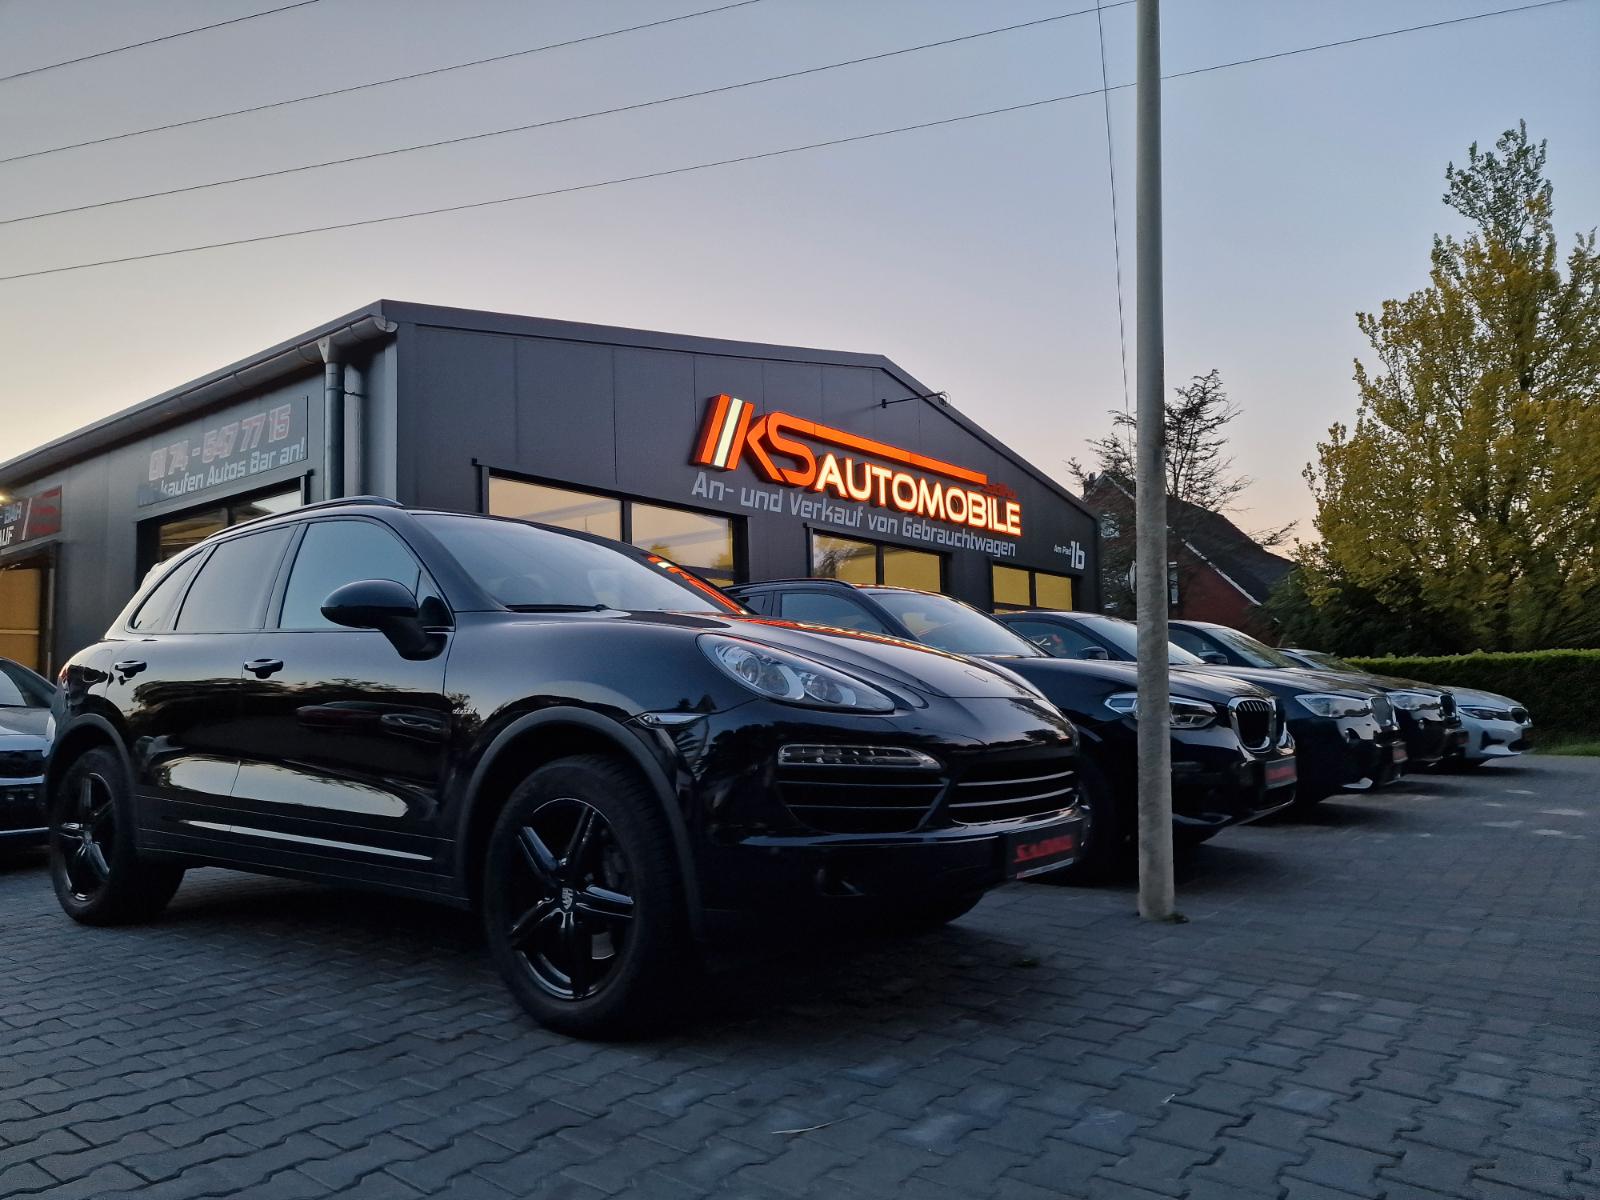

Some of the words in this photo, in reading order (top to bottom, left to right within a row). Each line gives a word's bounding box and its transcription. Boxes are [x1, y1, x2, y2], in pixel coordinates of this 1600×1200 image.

[206, 460, 246, 486] Autos
[250, 449, 276, 474] Bar
[279, 437, 305, 464] an!
[814, 452, 1022, 538] AUTOMOBILE
[691, 471, 734, 501] An-
[740, 487, 783, 513] und
[790, 492, 863, 528] Verkauf
[868, 513, 898, 535] von
[902, 517, 1016, 558] Gebrauchtwagen
